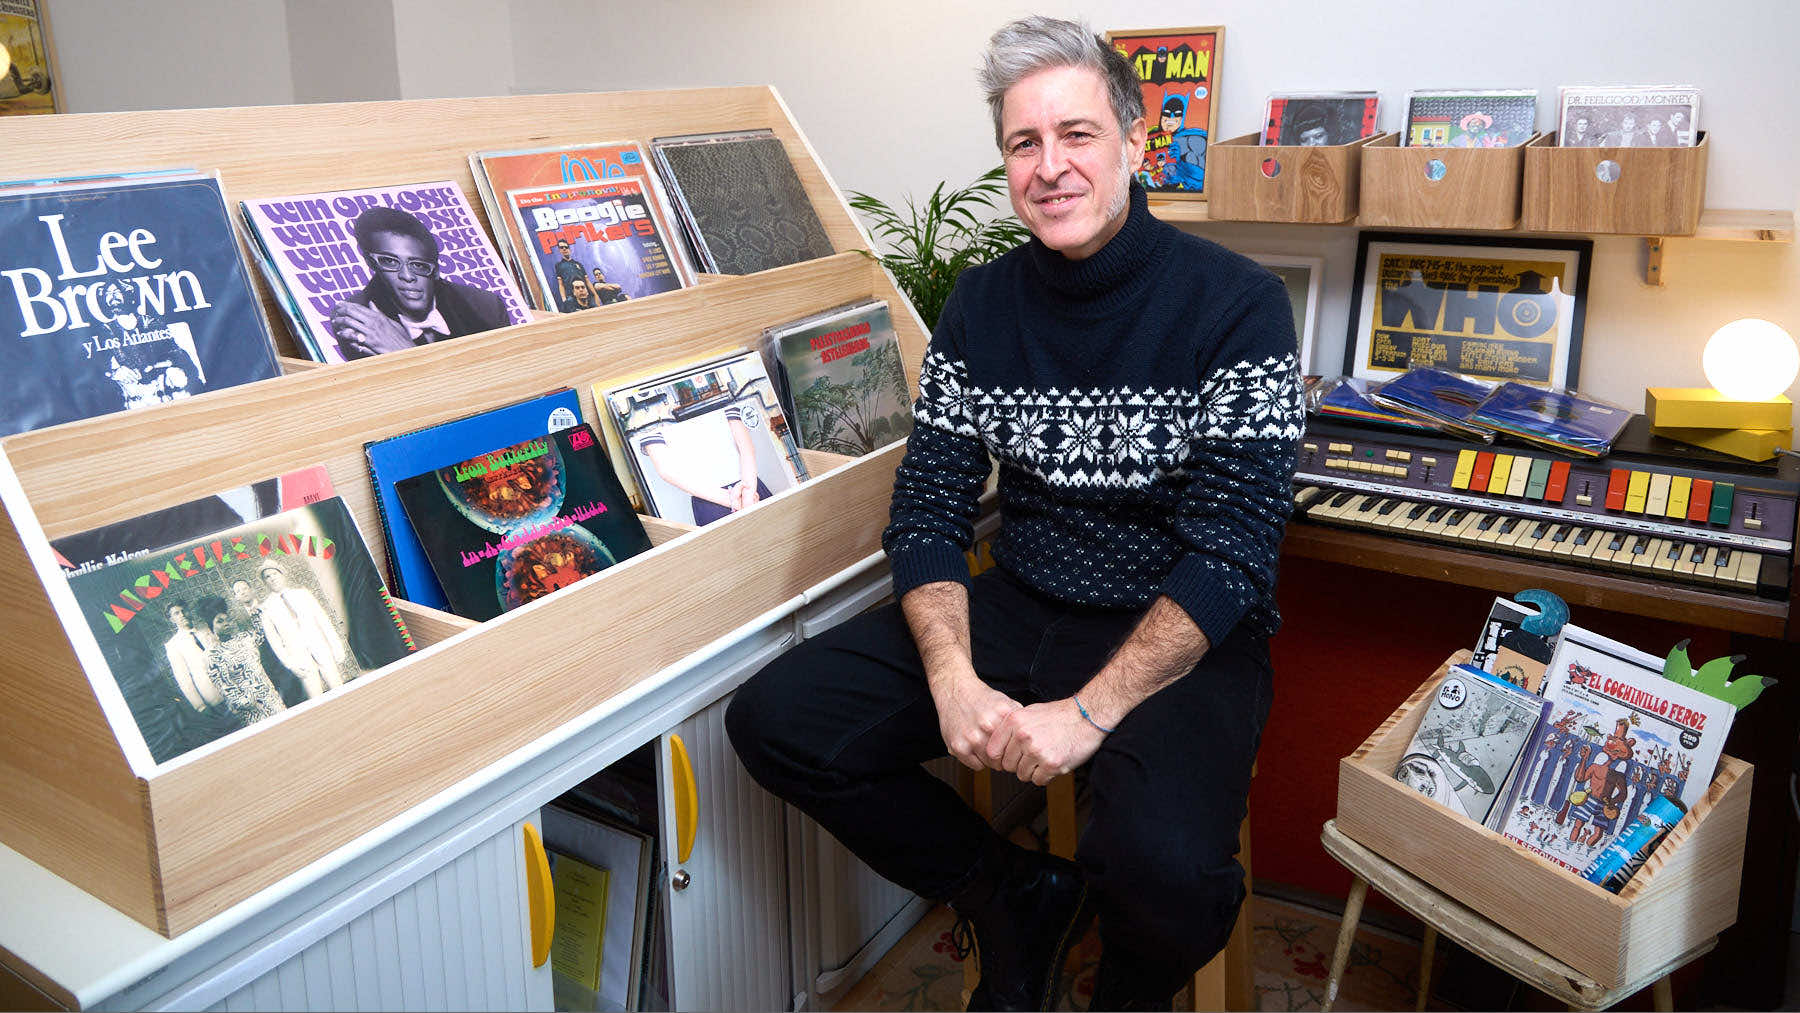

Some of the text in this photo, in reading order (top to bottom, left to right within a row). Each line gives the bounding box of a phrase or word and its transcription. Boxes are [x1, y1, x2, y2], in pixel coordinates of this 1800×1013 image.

[1165, 50, 1210, 79] MAN
[1644, 94, 1692, 105] MONKEY
[1154, 134, 1173, 149] MAN
[259, 199, 335, 224] WIN
[333, 195, 377, 218] OR
[532, 199, 647, 232] Boogie
[38, 213, 163, 281] Lee
[271, 220, 347, 247] WIN
[283, 242, 359, 270] WIN
[295, 264, 370, 294] WIN
[1, 268, 212, 338] Brown
[1381, 278, 1558, 339] WHO
[82, 328, 171, 358] y Los Atlantes
[486, 440, 549, 471] Butterfly
[104, 548, 150, 567] Nelson
[103, 533, 336, 634] MICHELLE DAVID
[1588, 672, 1602, 690] EL
[1603, 678, 1668, 715] COCHINILLO
[1668, 703, 1707, 730] FEROZ
